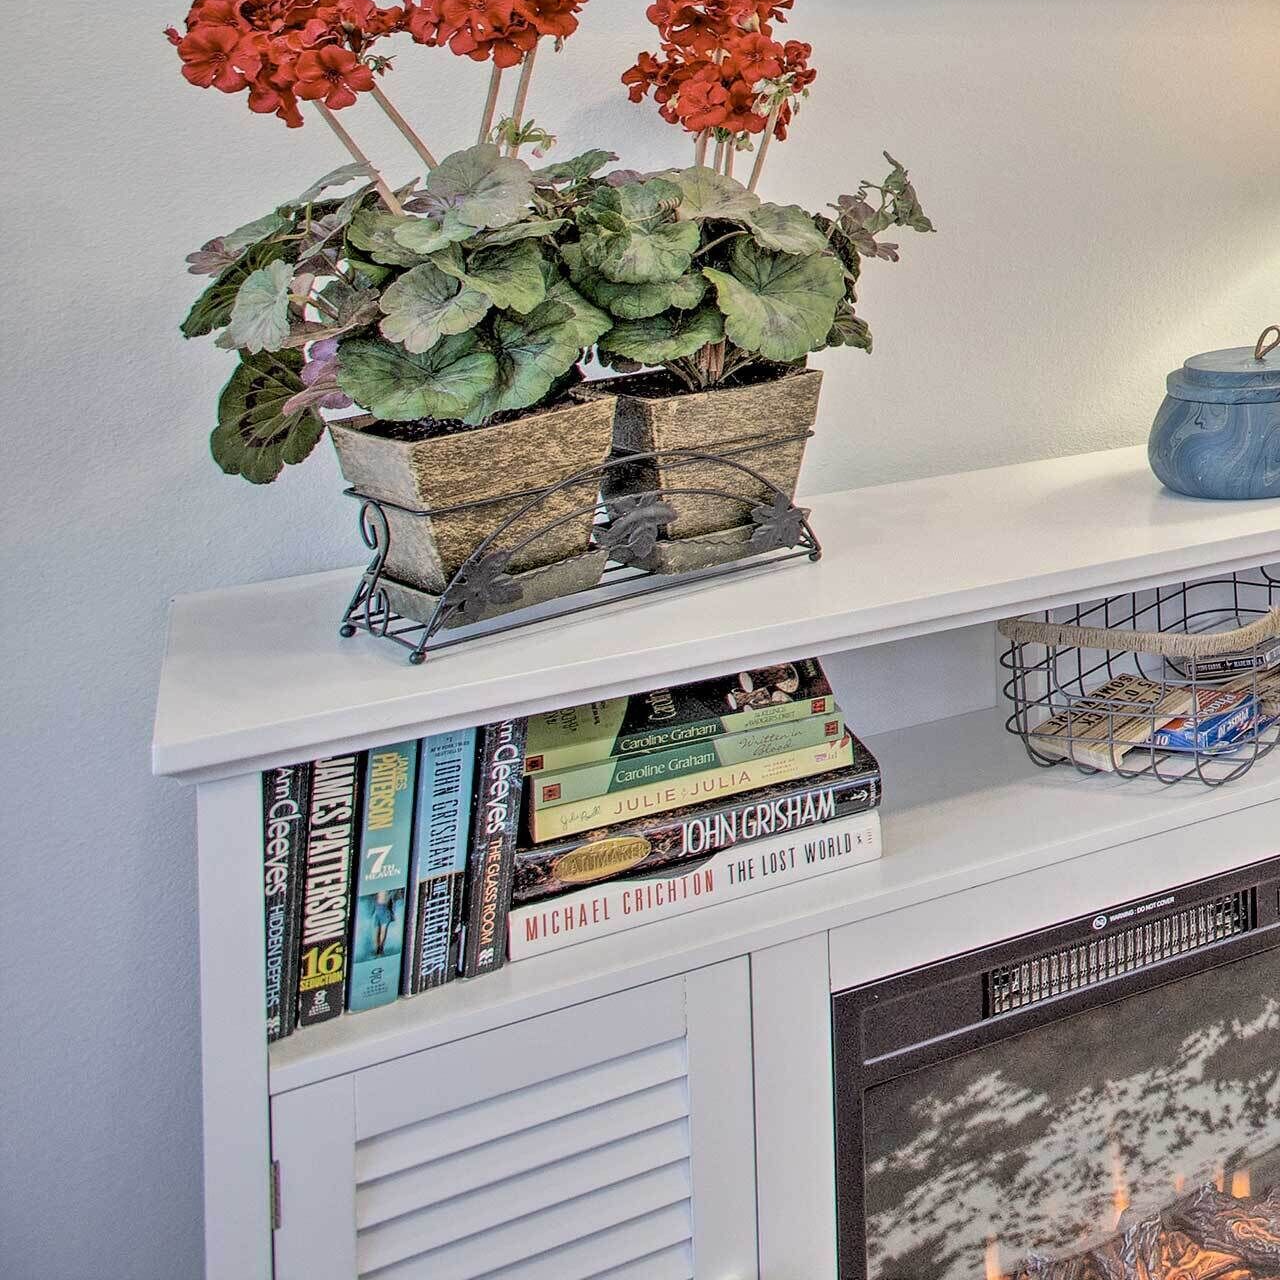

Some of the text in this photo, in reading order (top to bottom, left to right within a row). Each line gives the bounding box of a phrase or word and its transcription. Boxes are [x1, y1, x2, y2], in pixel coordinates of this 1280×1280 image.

[615, 751, 716, 783] Caroline Graham
[620, 723, 717, 751] Caroline Graham
[311, 755, 355, 825] JAMES
[368, 752, 399, 832] PATTERSON
[427, 758, 462, 872] JOHN GRISHAM
[485, 744, 522, 834] Cleeves
[613, 788, 677, 815] JULIE
[690, 770, 752, 797] JULIA
[678, 810, 737, 857] JOHN
[742, 787, 836, 839] GRISHAM
[264, 798, 302, 896] Cleeves
[302, 823, 351, 946] PATTERSON
[479, 836, 503, 945] THE GLASS ROOM
[525, 896, 610, 942] MICHAEL
[623, 869, 714, 915] CRICHTON
[727, 857, 754, 885] THE
[761, 847, 796, 877] LOST
[804, 832, 852, 865] WORLD
[266, 903, 285, 1008] HIDDEN DEPTHS
